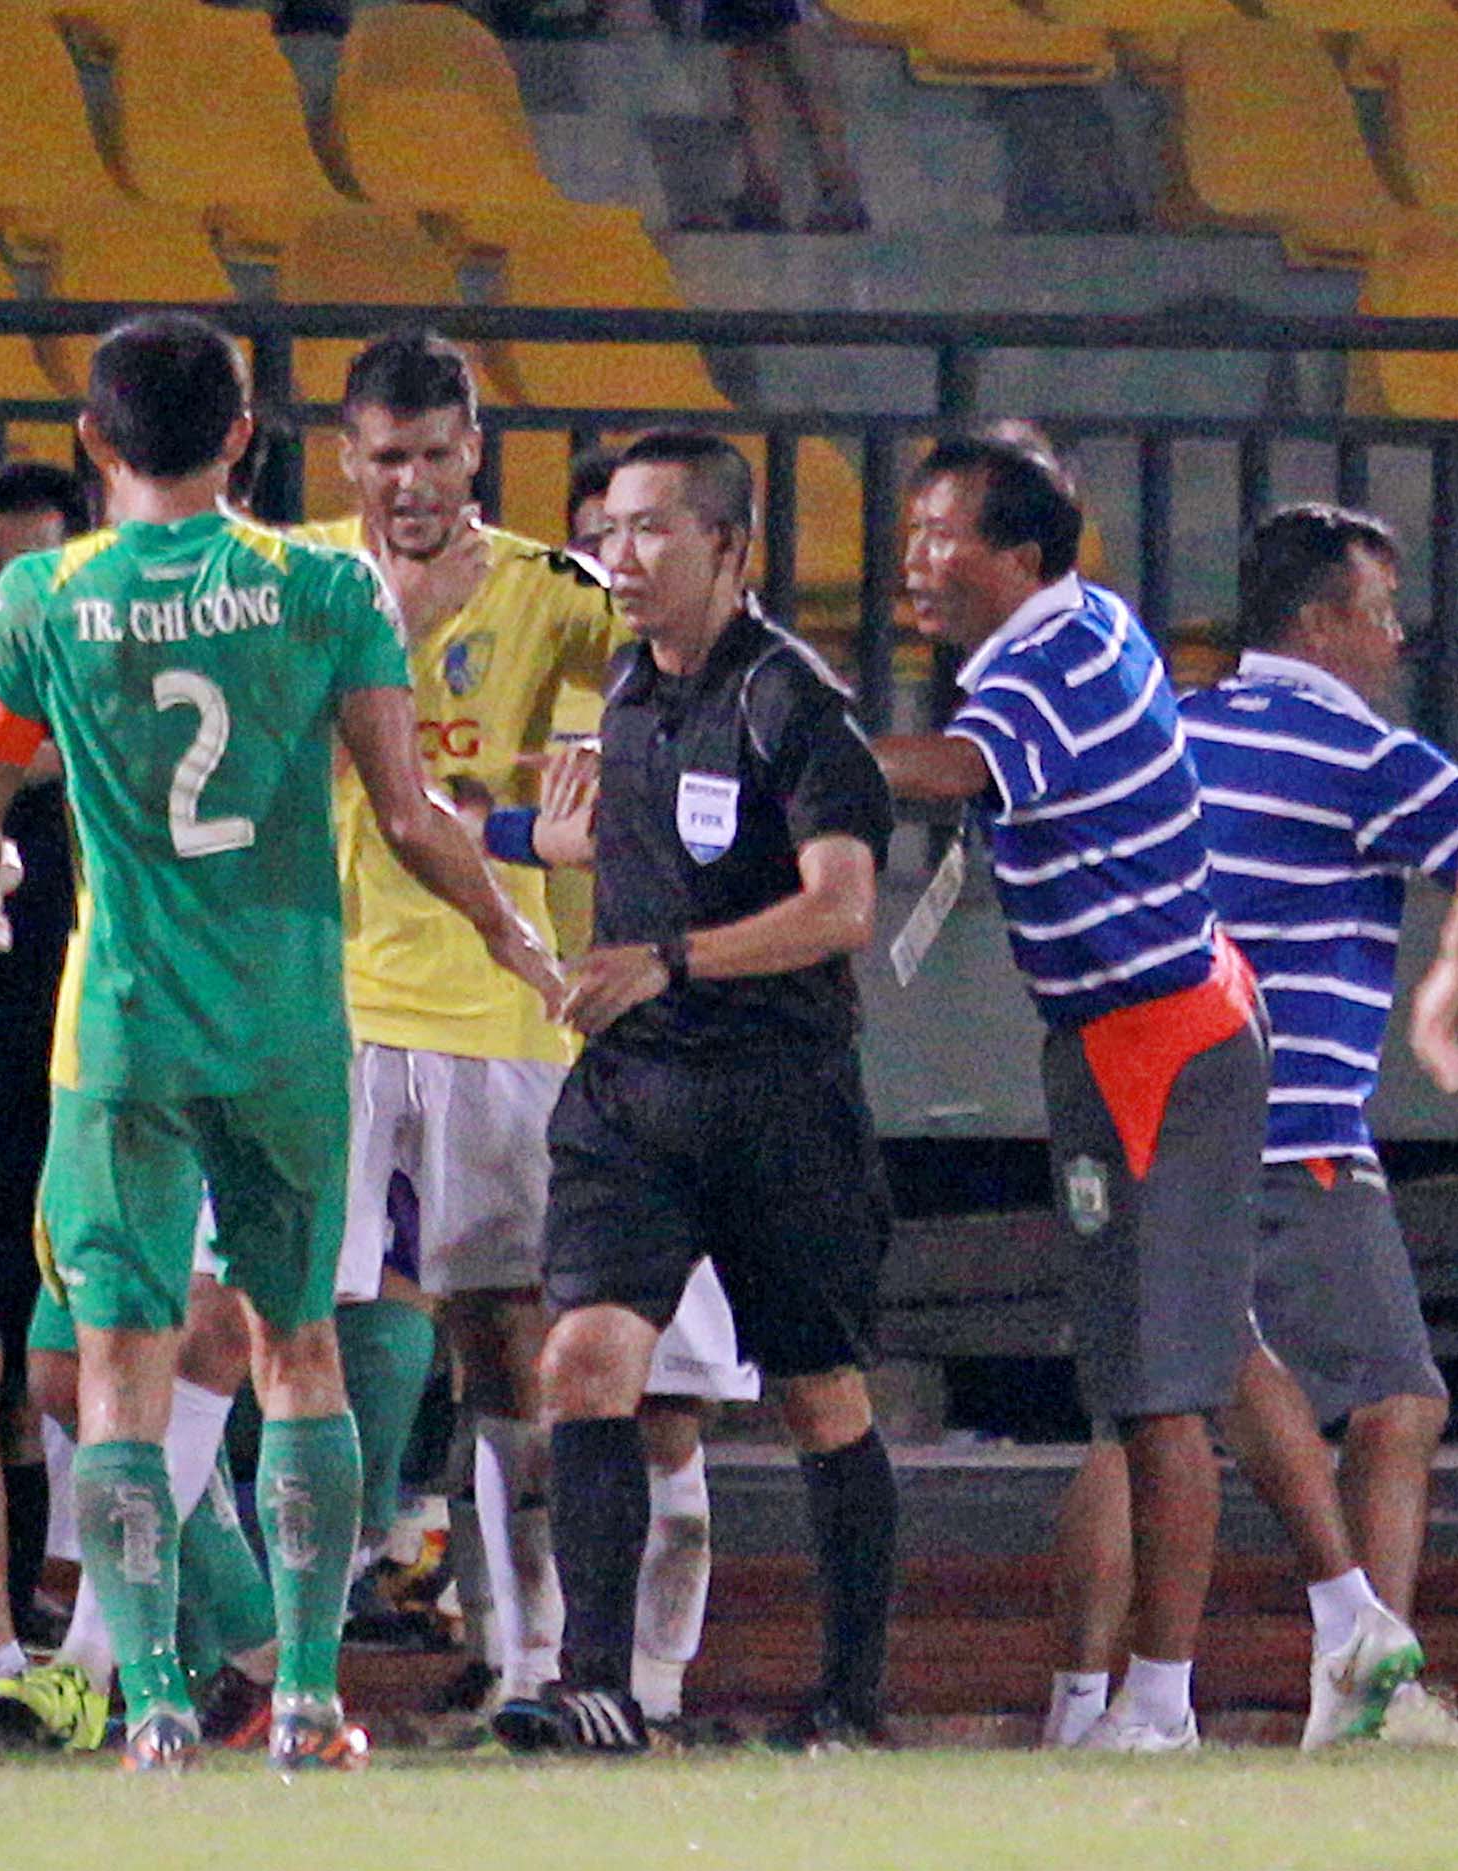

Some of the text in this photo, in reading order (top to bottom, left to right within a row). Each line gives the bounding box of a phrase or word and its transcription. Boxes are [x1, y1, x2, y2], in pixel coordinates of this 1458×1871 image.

[73, 599, 123, 642] TR.
[194, 583, 281, 637] CÔNG
[152, 669, 256, 859] 2
